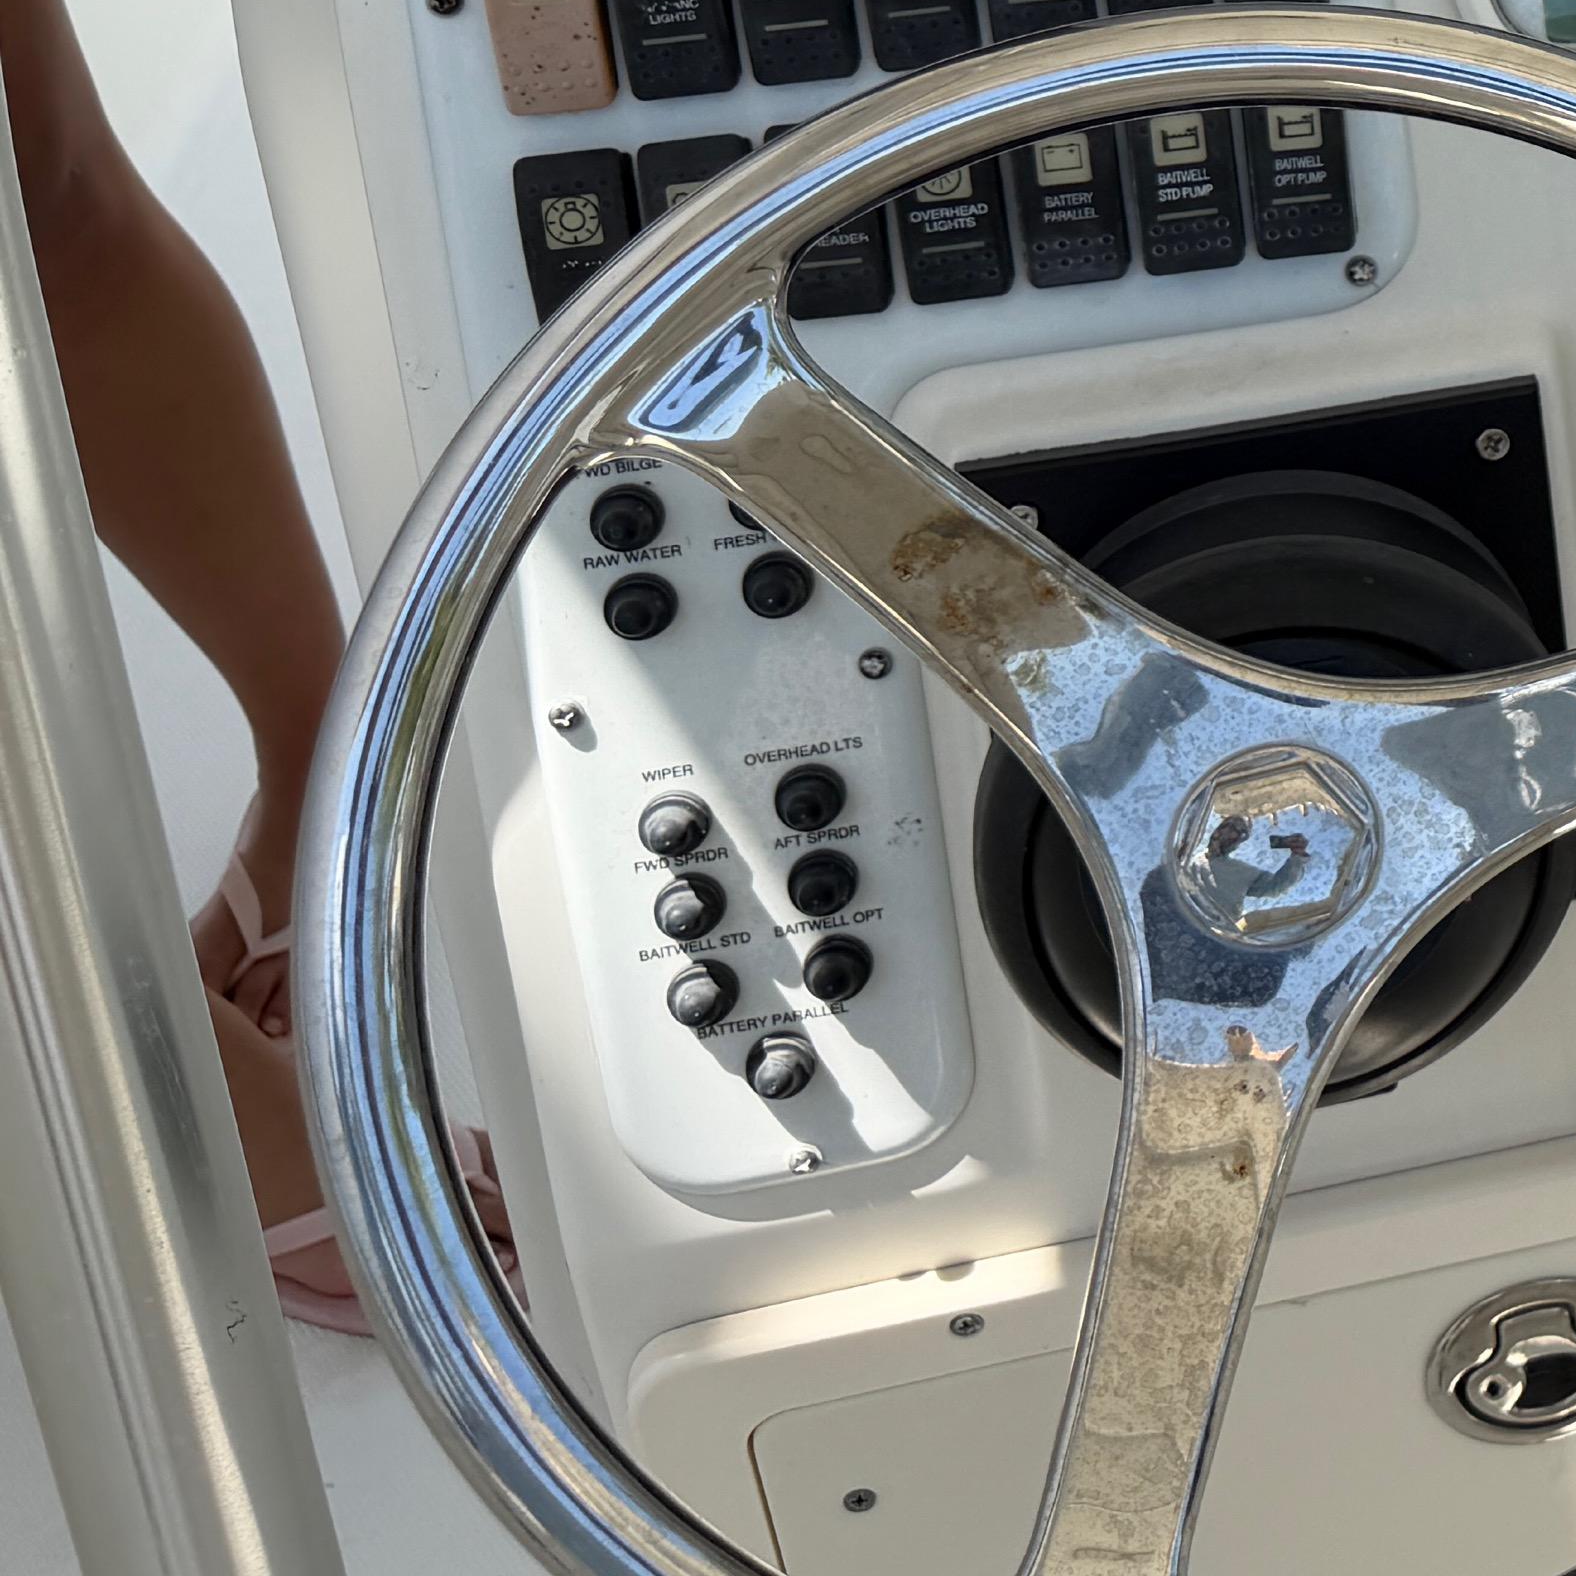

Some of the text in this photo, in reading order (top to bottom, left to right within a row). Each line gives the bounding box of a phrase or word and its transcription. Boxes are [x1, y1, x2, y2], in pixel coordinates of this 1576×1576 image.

[650, 10, 697, 25] LIGHTS
[1275, 155, 1324, 170] BAITWELL
[1158, 168, 1211, 185] BAITWELL
[1275, 171, 1328, 187] OPT PUMP
[1045, 192, 1094, 208] BATTERY
[1158, 184, 1214, 202] STD PUMP
[910, 204, 989, 223] OVERHEAD
[1044, 206, 1099, 222] PARALLEL
[925, 217, 977, 233] LIGHTS
[584, 464, 611, 478] WD
[714, 532, 767, 550] FRESH
[583, 544, 683, 571] RAW WATER
[744, 736, 864, 767] OVERHEAD LTS
[641, 764, 694, 783] WIPER
[774, 825, 861, 850] AFT SPRDR
[634, 847, 729, 874] FWD SPRDR
[774, 907, 884, 938] BAITWELL OPT
[639, 931, 751, 963] BAITWELL STD
[697, 1001, 849, 1040] BATTERY PARALLEL
